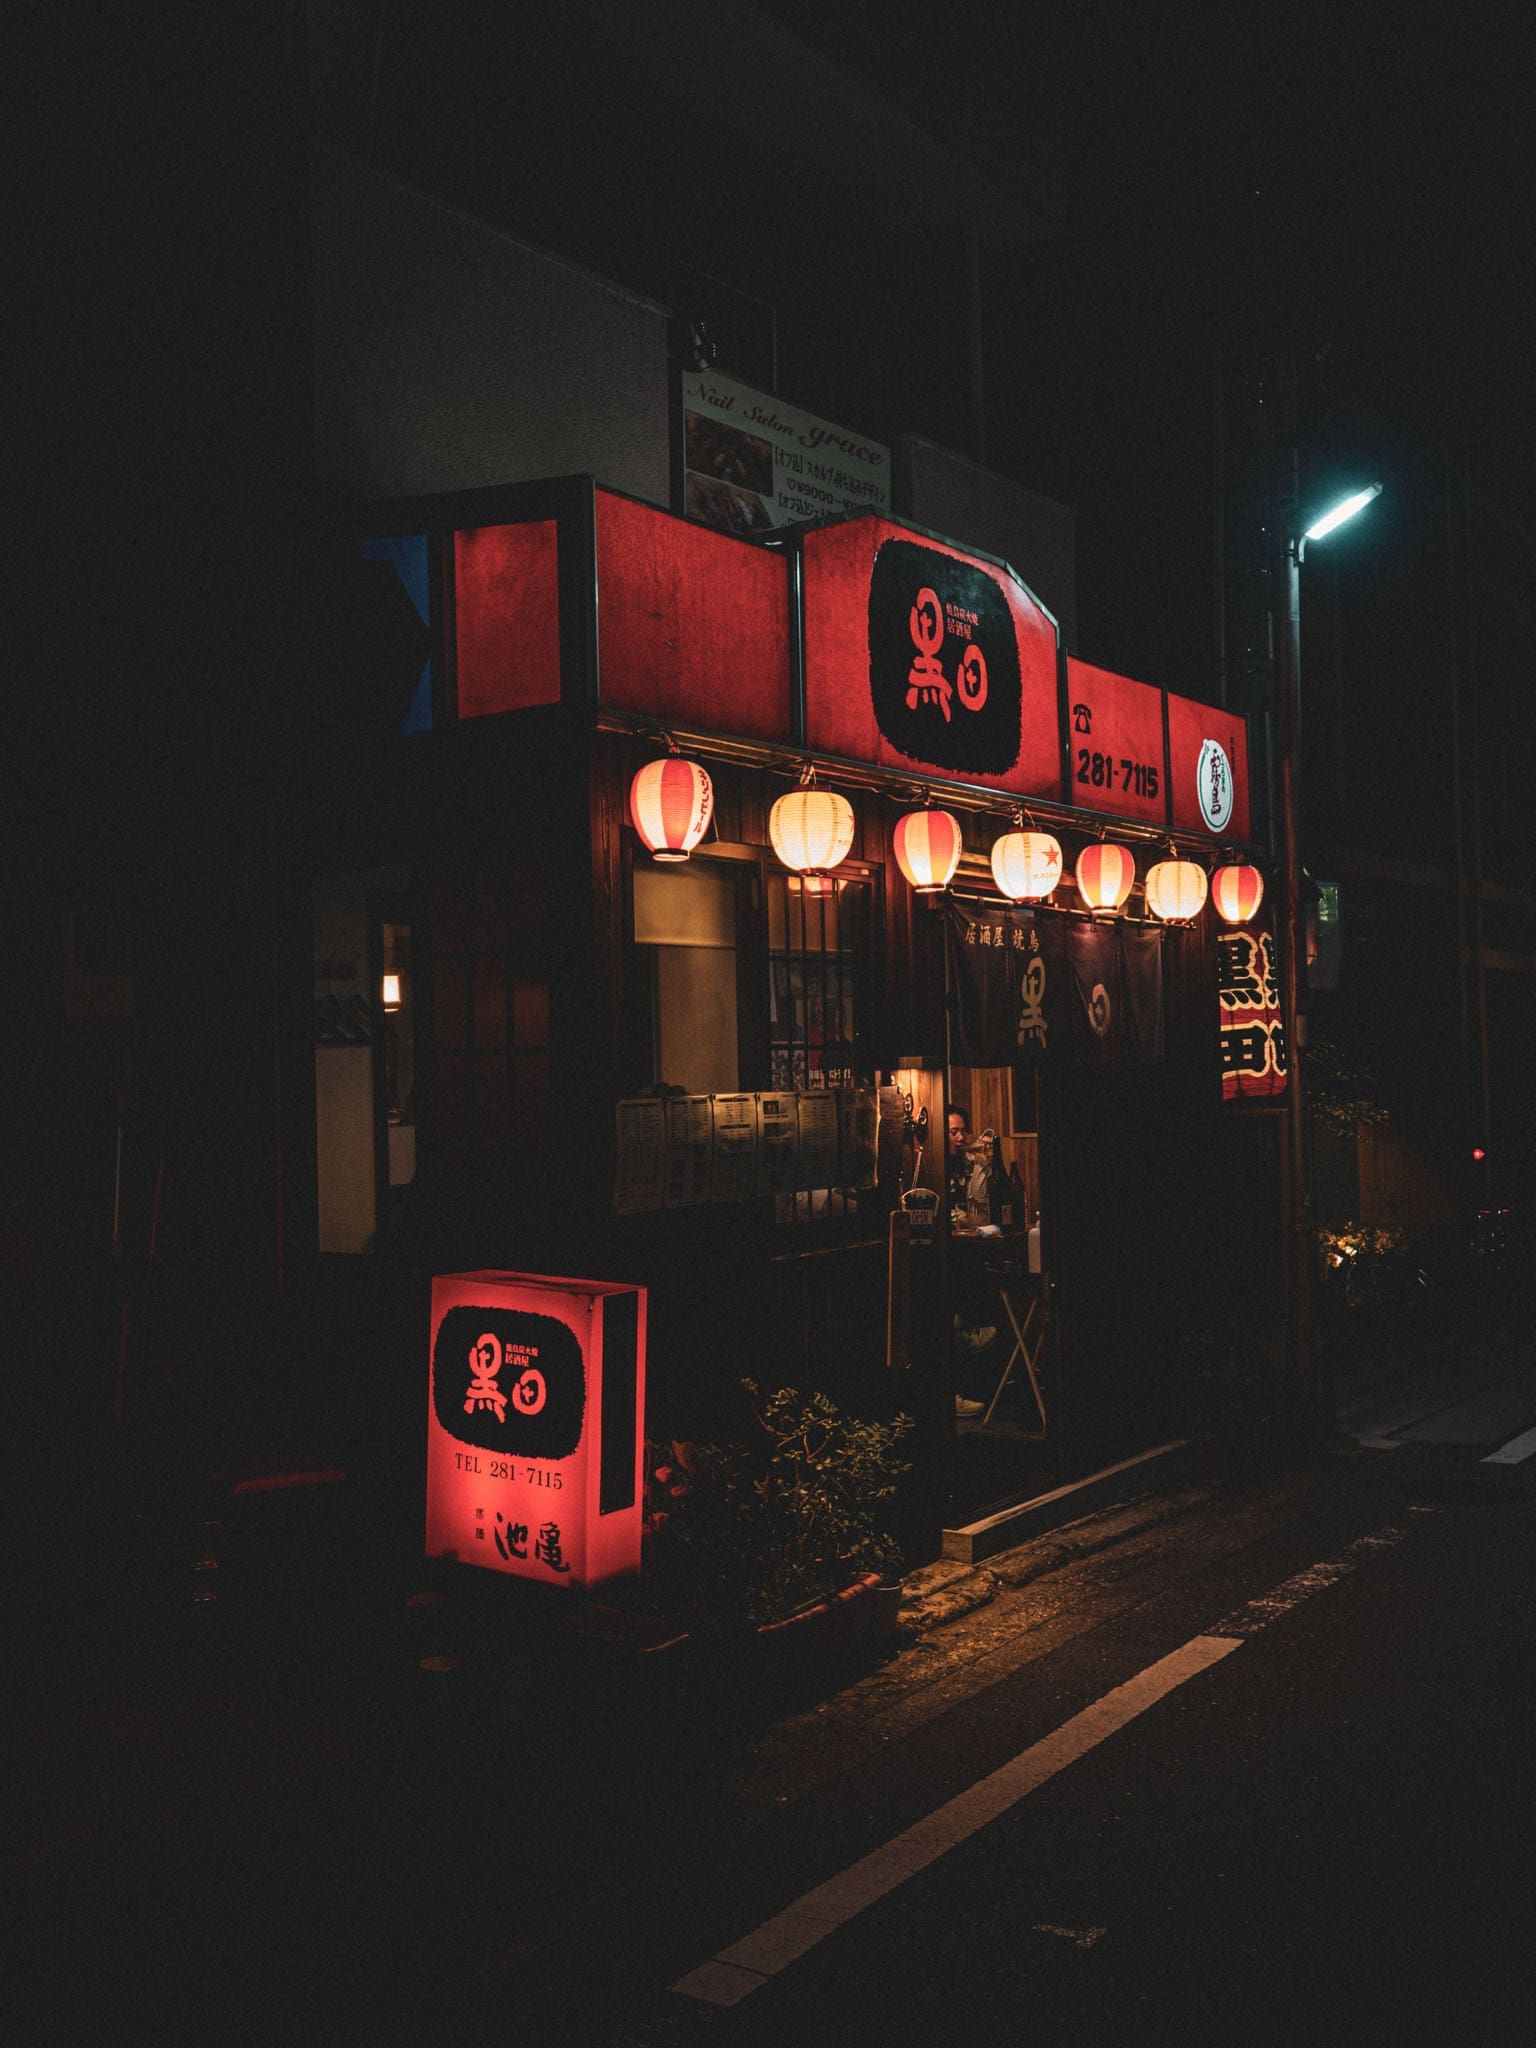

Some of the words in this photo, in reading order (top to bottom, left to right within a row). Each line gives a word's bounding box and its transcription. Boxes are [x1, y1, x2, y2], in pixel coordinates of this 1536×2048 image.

[687, 383, 735, 411] Nail
[743, 406, 793, 436] Salon
[799, 426, 883, 465] grace
[946, 617, 972, 640] 居酒屋
[905, 587, 988, 723] 黒田
[1077, 749, 1159, 799] 281-7115
[964, 921, 1005, 947] 居酒屋
[1012, 928, 1040, 952] 焼鳥
[463, 1333, 547, 1424] 黒田
[504, 1352, 530, 1367] 居酒屋
[455, 1453, 482, 1474] TEL
[490, 1461, 563, 1490] 281-7115
